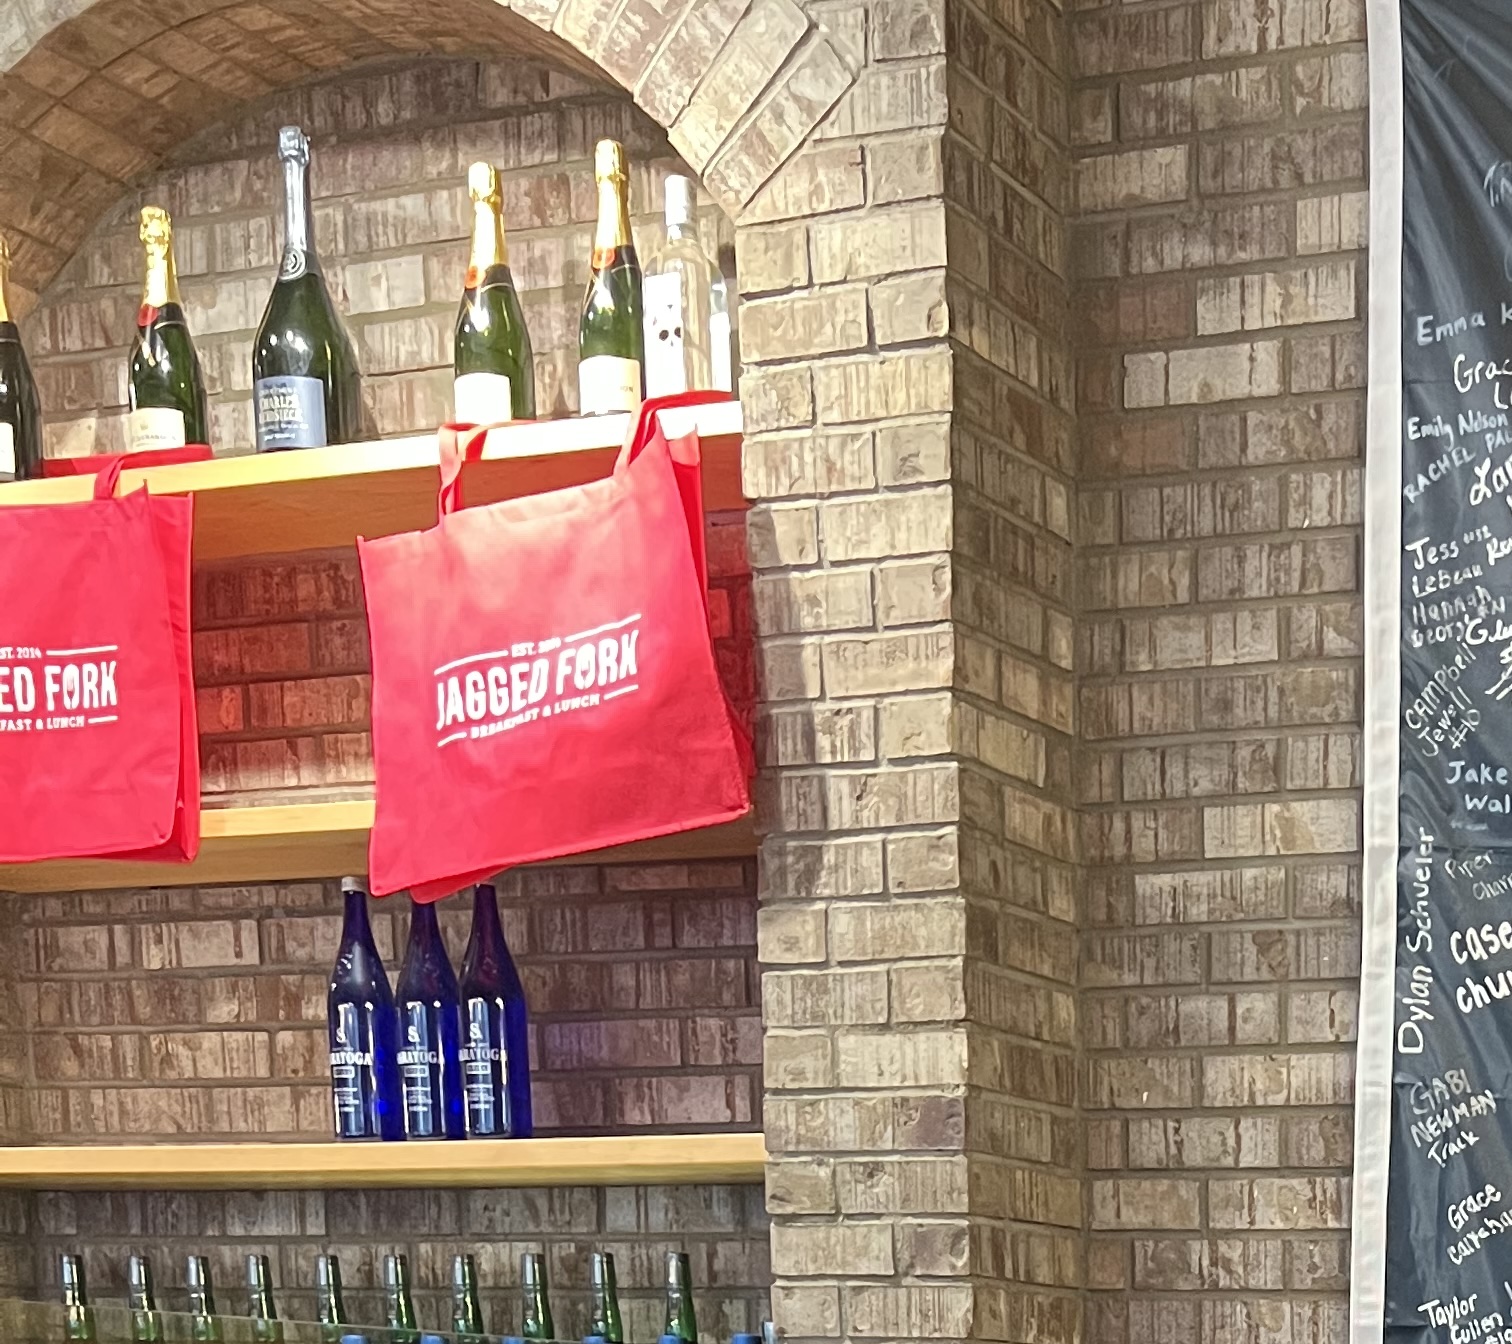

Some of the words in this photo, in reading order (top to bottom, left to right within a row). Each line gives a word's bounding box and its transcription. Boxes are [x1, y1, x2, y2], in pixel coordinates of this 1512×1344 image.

[1415, 308, 1487, 347] Emma
[44, 660, 118, 711] FORK
[435, 657, 551, 732] JAGGED
[555, 629, 640, 696] FORK
[46, 715, 85, 730] LUNCH
[553, 693, 601, 715] LUNCH
[1444, 761, 1510, 787] Jake
[1409, 1088, 1498, 1148] NEWMAN
